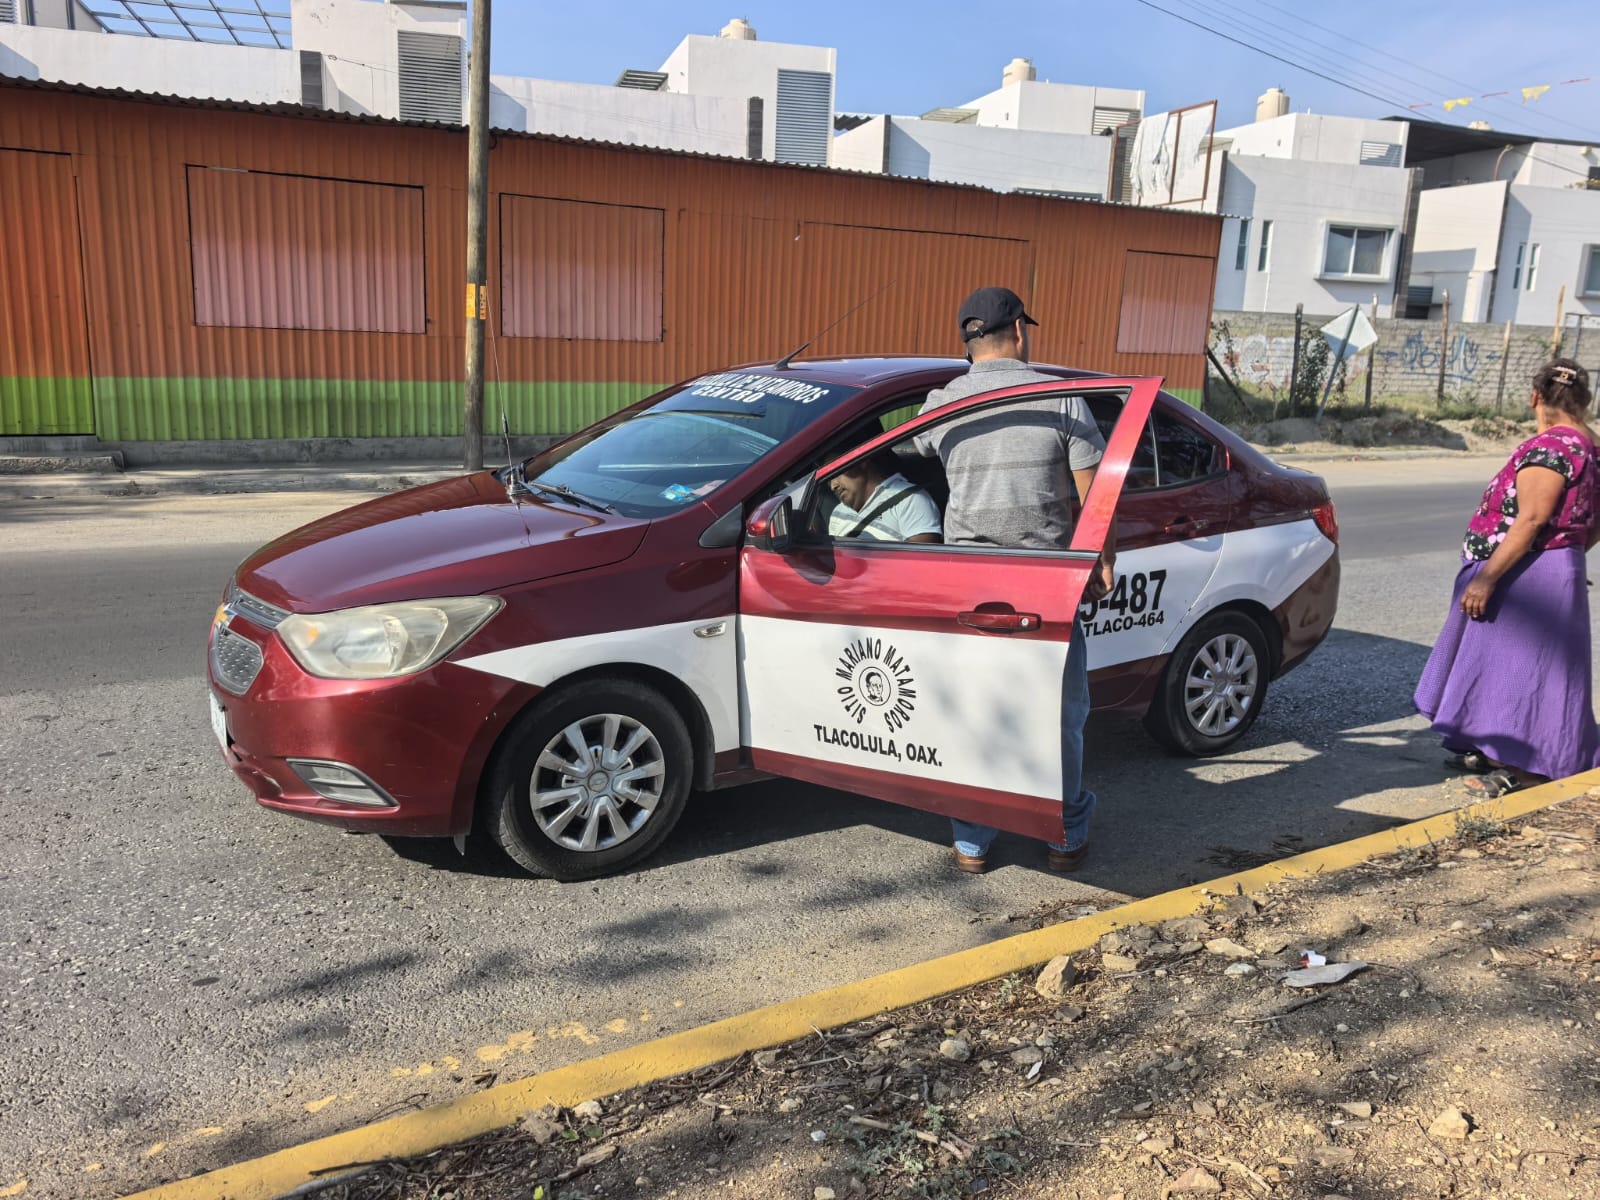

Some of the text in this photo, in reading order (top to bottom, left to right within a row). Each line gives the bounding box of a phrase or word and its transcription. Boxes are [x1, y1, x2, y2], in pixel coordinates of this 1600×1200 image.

[691, 386, 765, 403] CENTRO
[743, 376, 830, 404] MATAMOROS
[1083, 610, 1165, 637] TLACO-464
[835, 637, 917, 733] SITIO MARIANO MATAMOROS
[813, 724, 943, 766] TLACOLULA, OAX.
